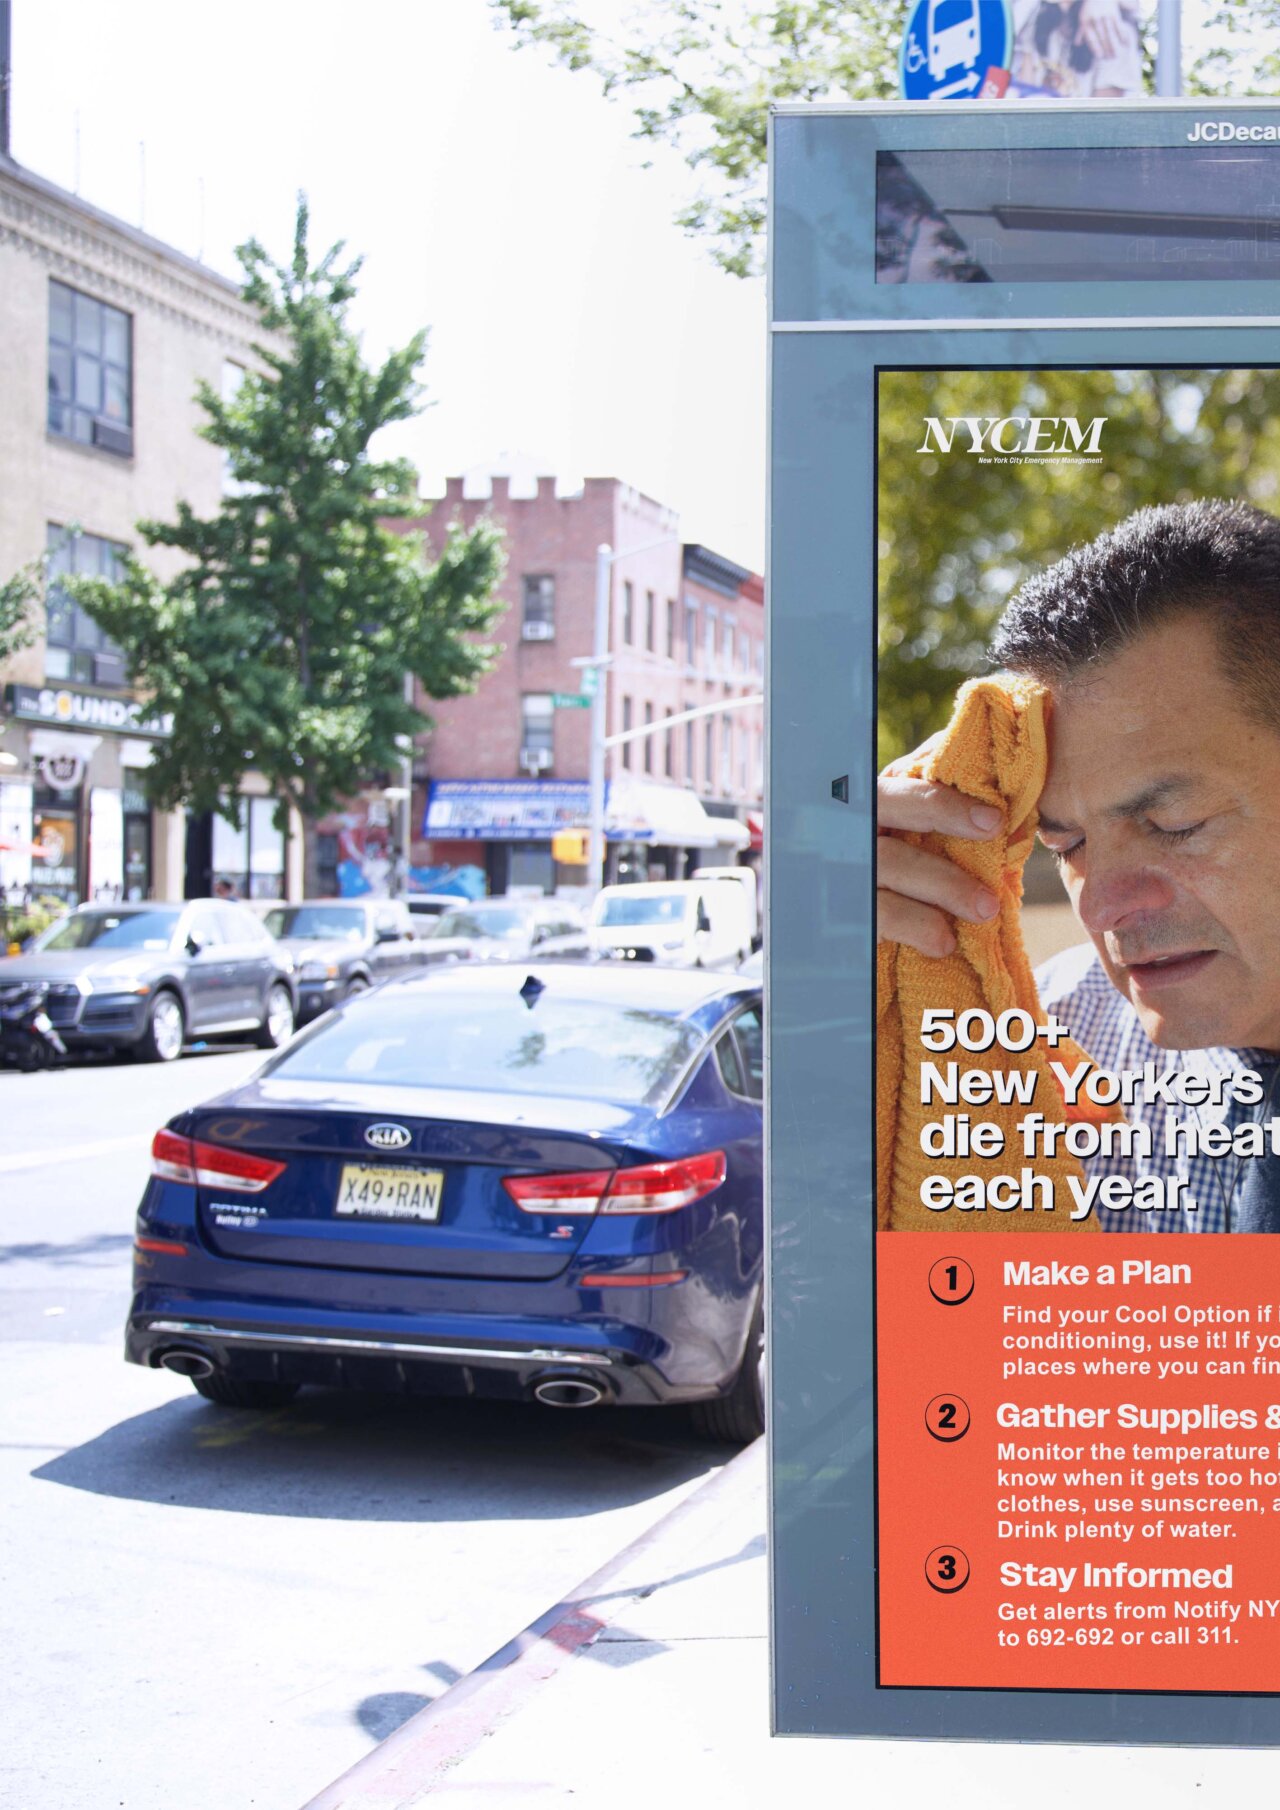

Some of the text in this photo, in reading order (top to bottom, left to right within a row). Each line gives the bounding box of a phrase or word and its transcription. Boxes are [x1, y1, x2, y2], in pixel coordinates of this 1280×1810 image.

[916, 417, 1108, 453] NYCEM
[978, 456, 1104, 466] New York City Emergency Management
[920, 1008, 1070, 1052] 500+
[920, 1061, 1264, 1106] New Yorkers
[920, 1114, 1005, 1158] die
[1017, 1112, 1152, 1158] from
[920, 1168, 1198, 1221] each year.
[944, 1265, 957, 1291] 1
[1003, 1259, 1192, 1286] Make a Plan
[1003, 1305, 1051, 1324] Find
[1058, 1309, 1109, 1328] your
[1115, 1305, 1167, 1323] Cool
[1174, 1304, 1250, 1327] Option
[1257, 1304, 1273, 1323] if
[1002, 1331, 1152, 1354] conditioning,
[1159, 1335, 1199, 1349] use
[1206, 1331, 1227, 1349] it!
[1235, 1330, 1251, 1349] If
[1003, 1357, 1076, 1380] places
[1082, 1357, 1151, 1375] where
[1157, 1361, 1198, 1380] you
[1205, 1361, 1245, 1375] can
[937, 1403, 956, 1429] 2
[996, 1402, 1111, 1429] Gather
[1117, 1403, 1258, 1435] Supplies
[997, 1442, 1085, 1461] Monitor
[1090, 1442, 1126, 1461] the
[1132, 1443, 1270, 1465] temperature
[997, 1468, 1057, 1487] know
[1063, 1468, 1123, 1487] when
[1130, 1468, 1145, 1486] it
[1151, 1469, 1199, 1491] gets
[1205, 1468, 1243, 1486] too
[997, 1494, 1087, 1515] clothes,
[1094, 1498, 1134, 1512] use
[1140, 1498, 1265, 1515] sunscreen,
[997, 1519, 1237, 1543] Drink plenty of water.
[937, 1554, 956, 1581] 3
[1000, 1561, 1233, 1593] Stay Informed
[997, 1602, 1038, 1621] Get
[1043, 1602, 1108, 1620] alerts
[1114, 1601, 1167, 1620] from
[1174, 1600, 1241, 1623] Notify
[997, 1626, 1239, 1647] to 692-692 or call 311.
